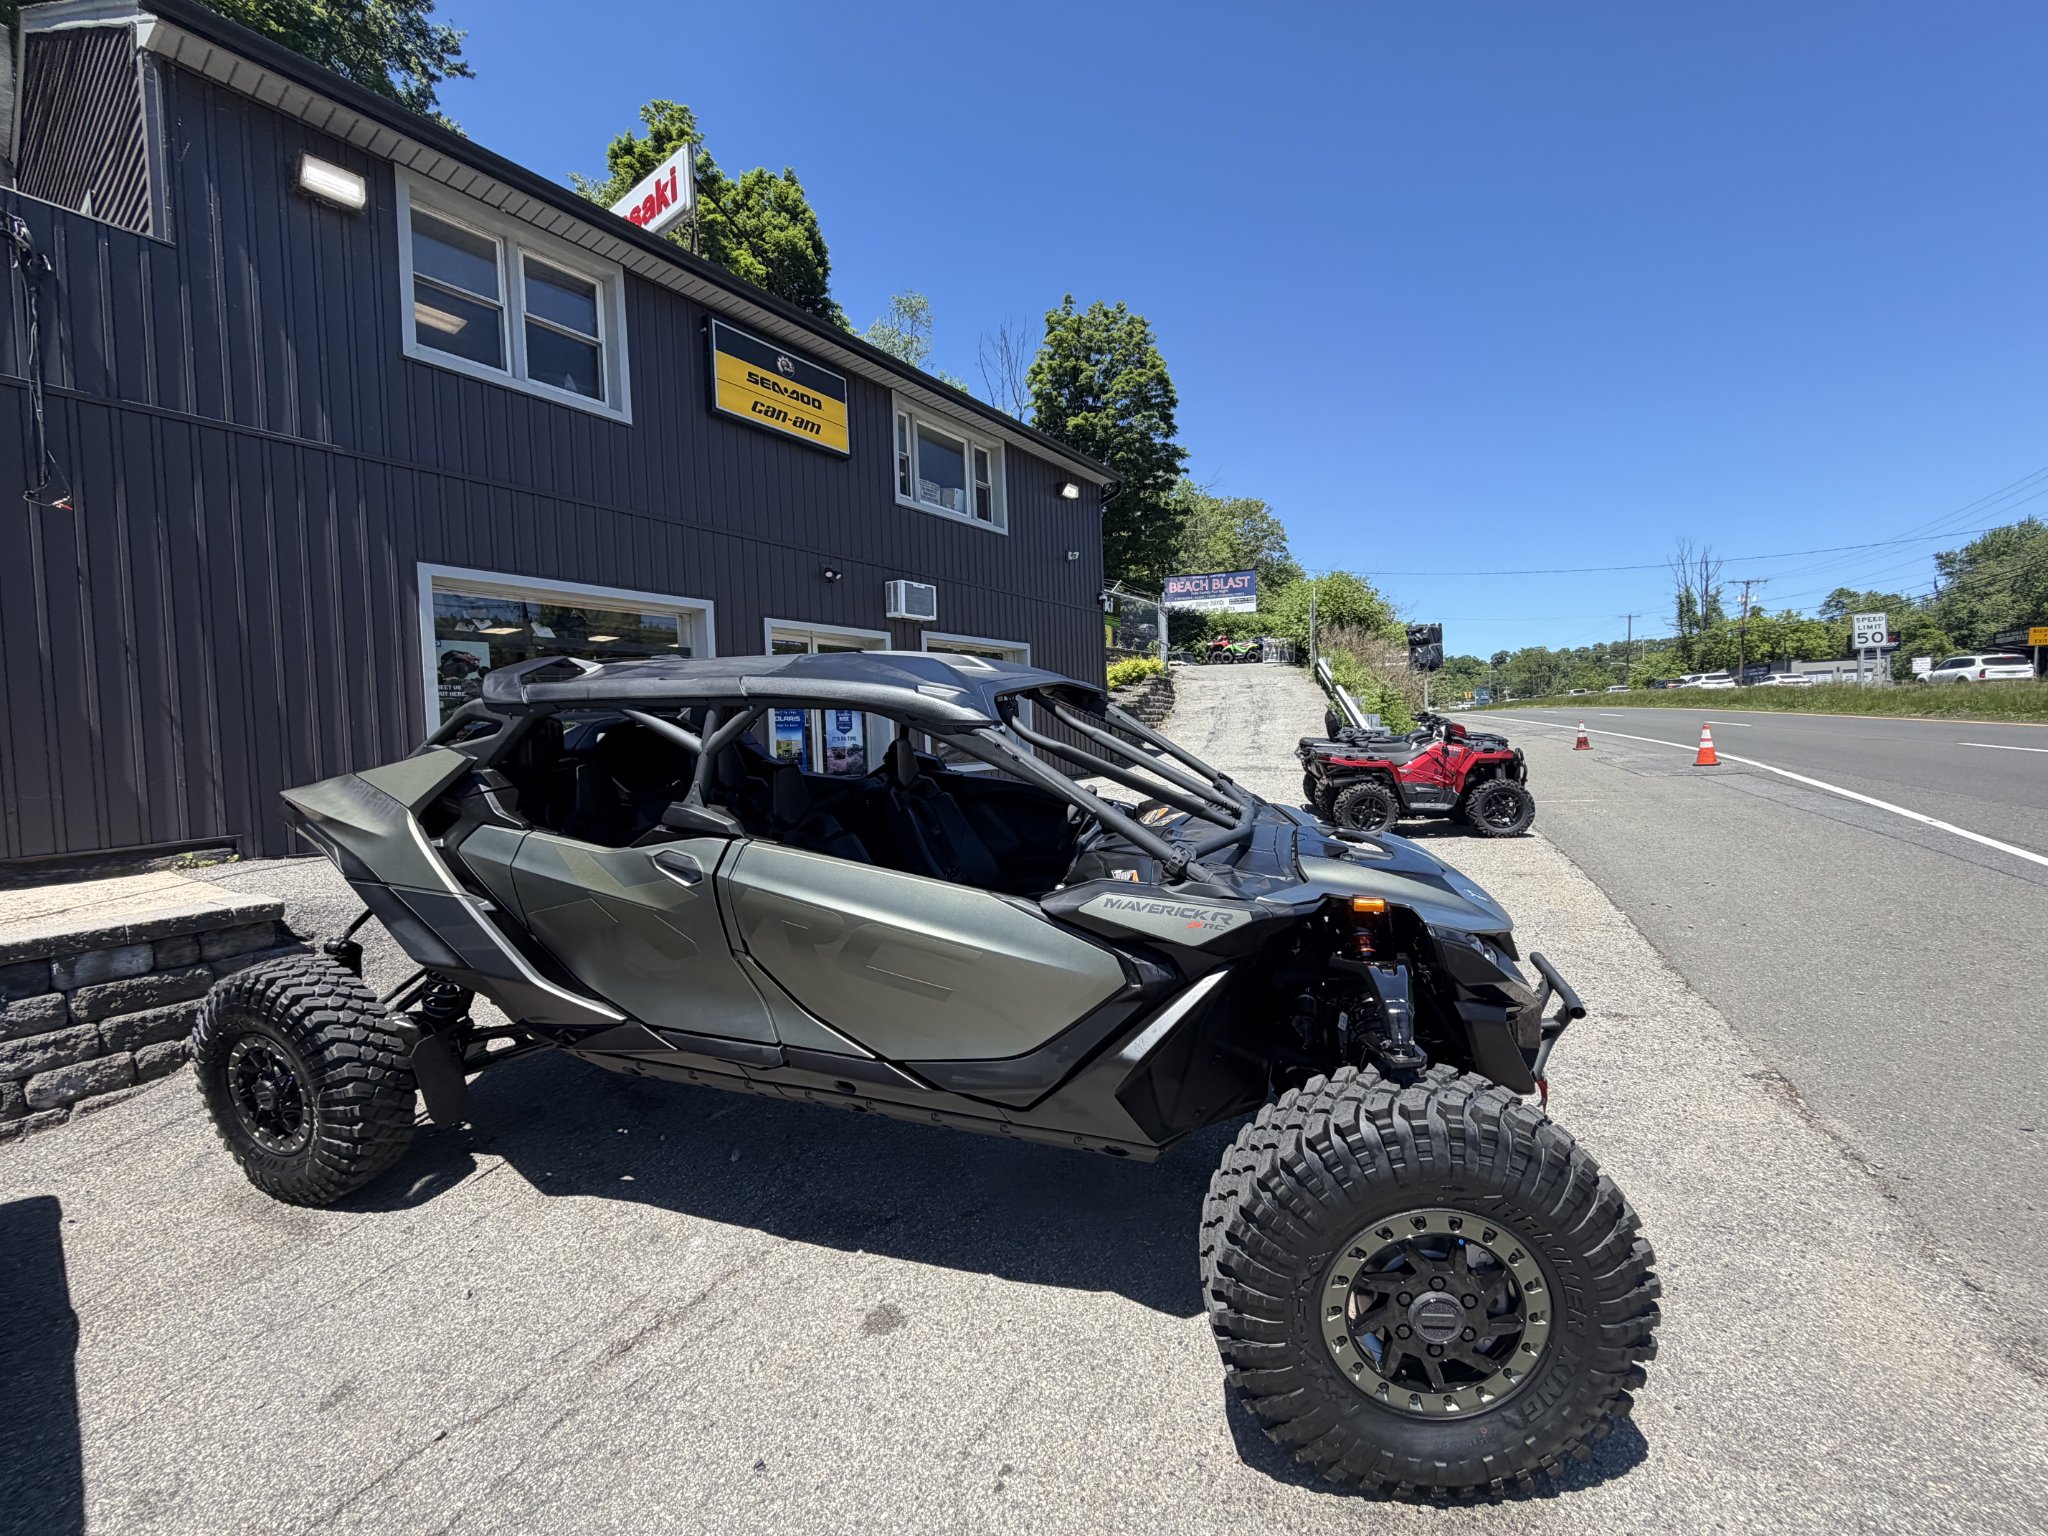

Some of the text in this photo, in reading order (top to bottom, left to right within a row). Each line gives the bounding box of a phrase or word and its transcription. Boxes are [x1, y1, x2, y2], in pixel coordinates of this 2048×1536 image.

[624, 166, 678, 228] saki
[1168, 579, 1209, 594] BEACH
[1212, 576, 1251, 590] BLAST
[1857, 623, 1882, 631] LIMIT
[1857, 631, 1884, 644] 50
[1103, 897, 1210, 921] MAVERICK
